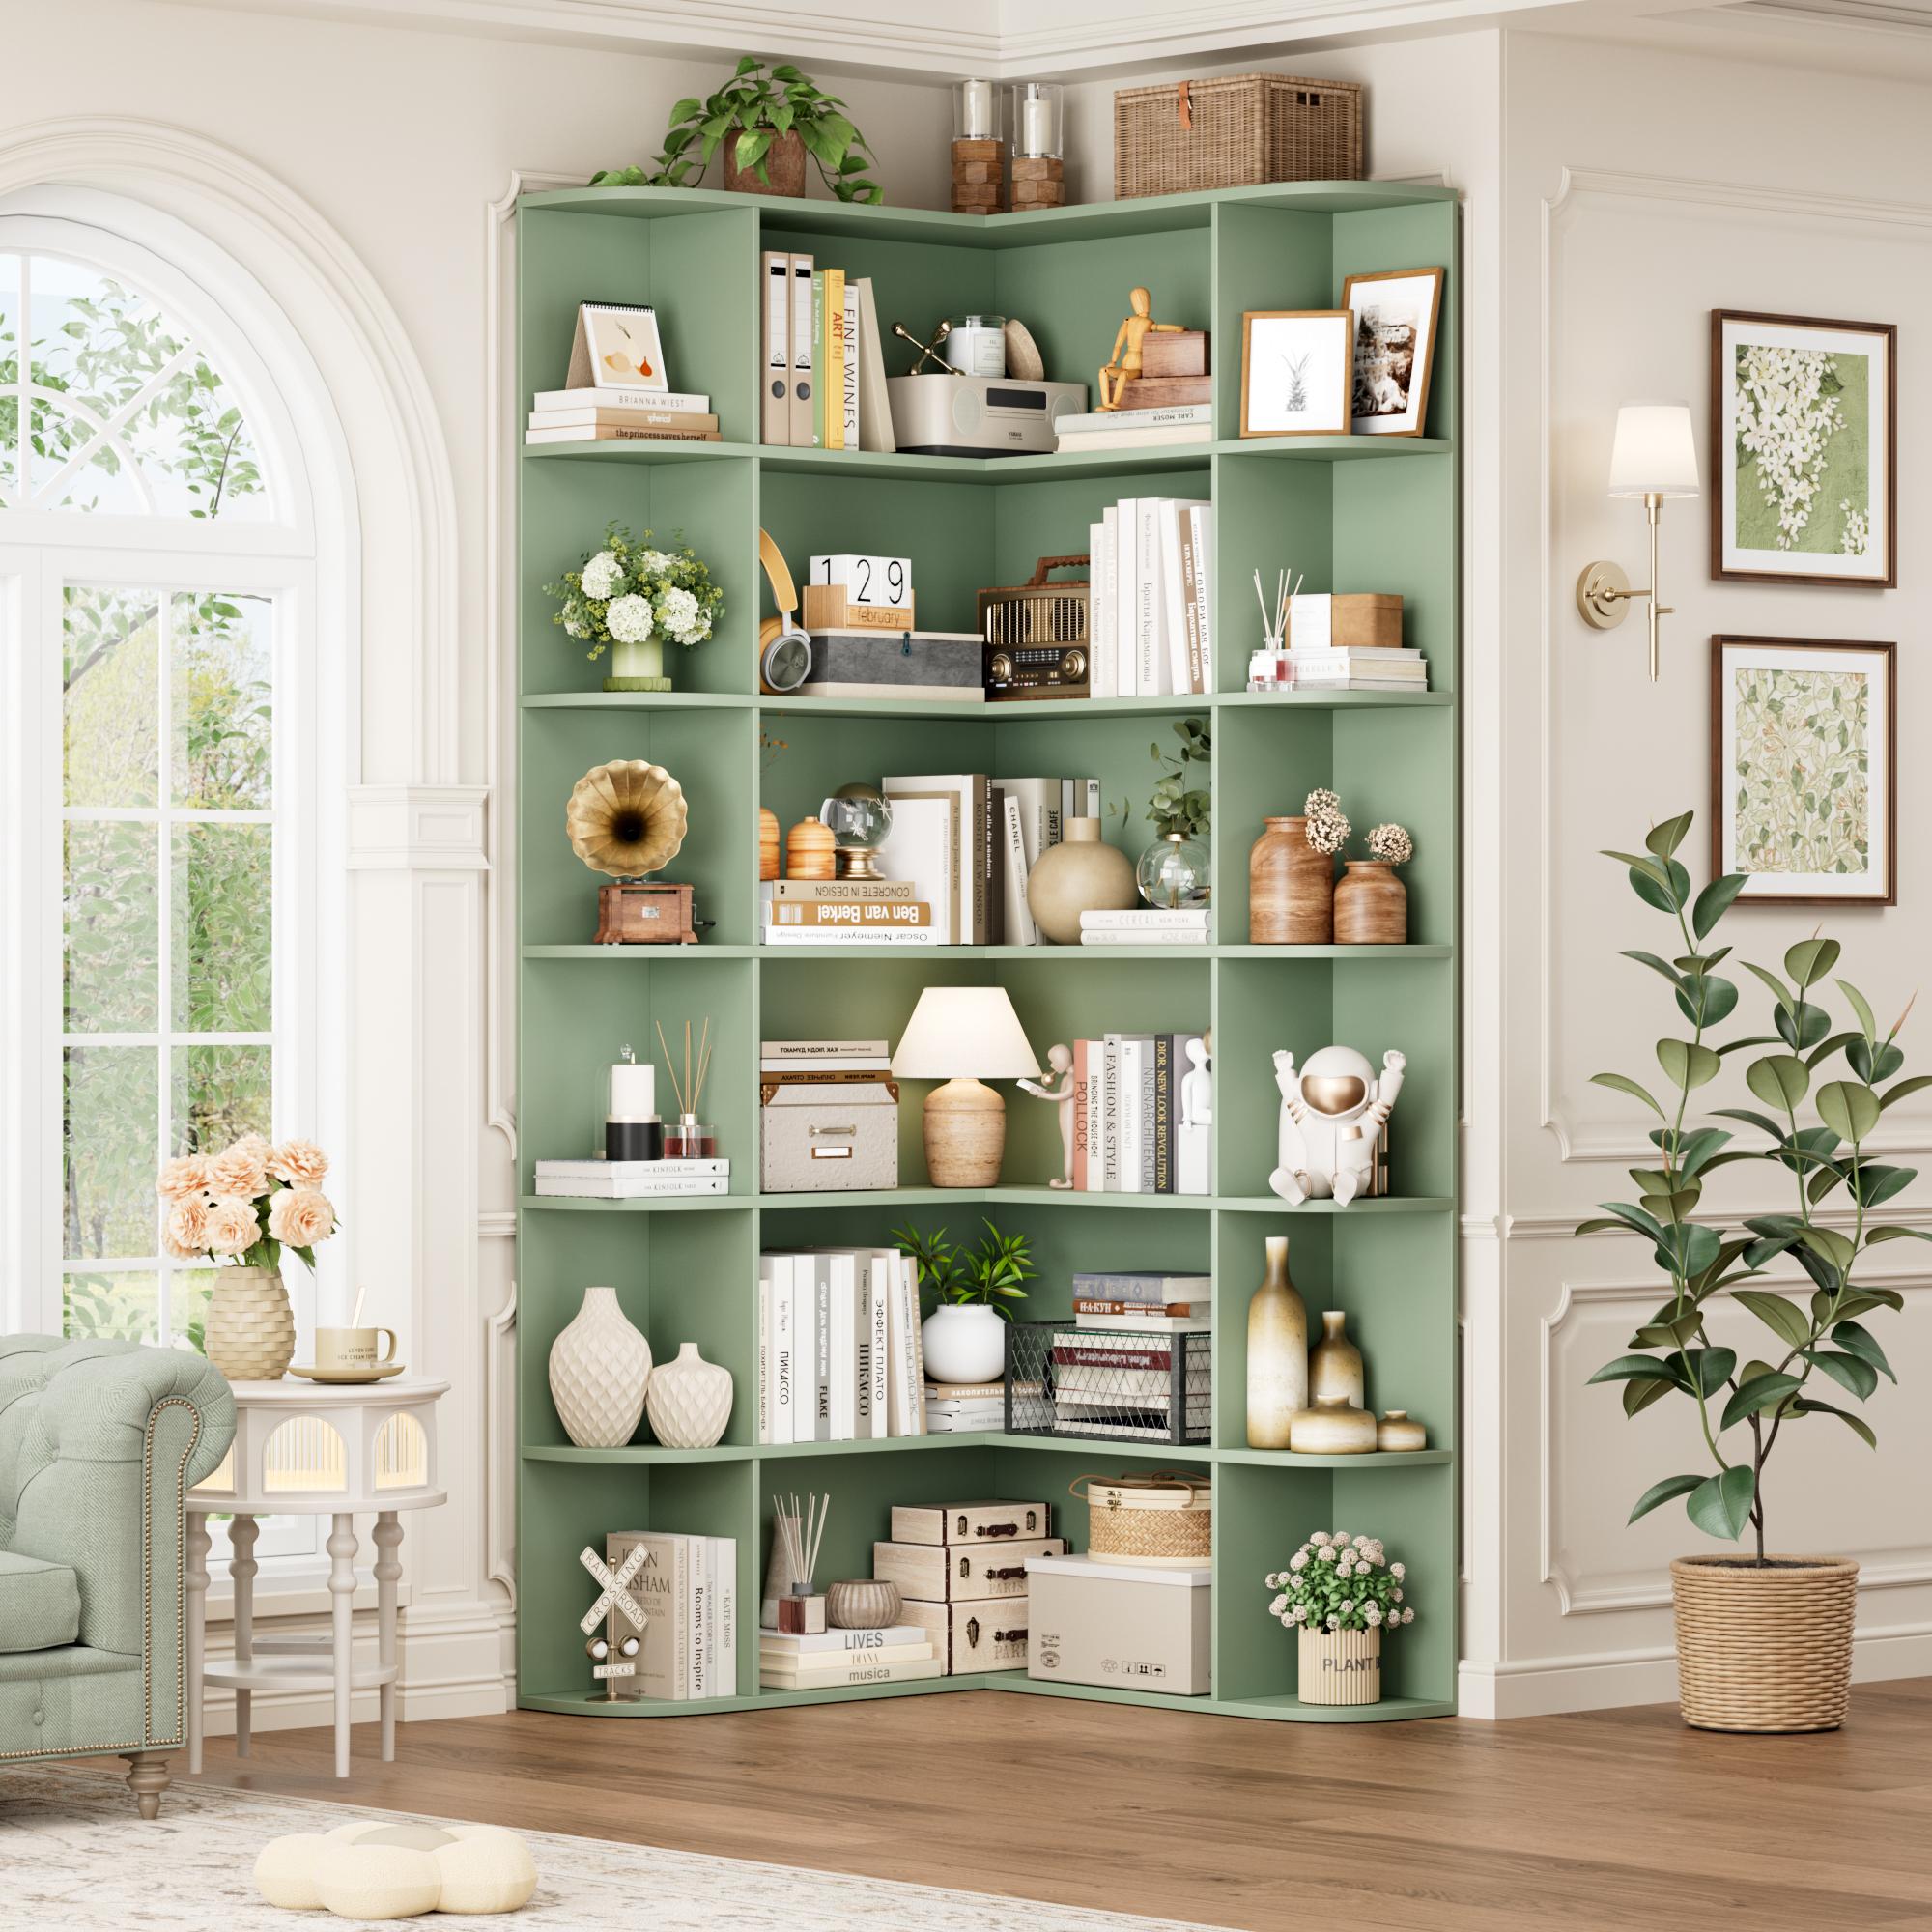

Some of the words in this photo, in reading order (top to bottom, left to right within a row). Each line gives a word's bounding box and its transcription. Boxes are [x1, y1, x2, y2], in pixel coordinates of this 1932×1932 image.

[833, 312, 843, 340] ART
[618, 395, 657, 405] BRIANNA
[661, 399, 685, 408] WIEST
[1140, 582, 1152, 617] Братья
[858, 606, 900, 627] february
[1140, 620, 1152, 682] Карамазовы
[1009, 806, 1021, 853] CHANEL
[816, 886, 849, 897] DESIGN
[851, 886, 860, 896] IN
[863, 886, 910, 897] CONCRETE
[818, 905, 861, 923] Berkel
[865, 905, 889, 919] van
[893, 905, 919, 923] Ben
[840, 932, 893, 941] Niemeyer
[896, 933, 928, 942] Oscar
[1106, 1055, 1117, 1117] FASHION
[1157, 1070, 1167, 1094] NEW
[1076, 1081, 1088, 1151] POLLOCK
[1157, 1095, 1167, 1122] LOOK
[1106, 1122, 1116, 1131] &
[1143, 1064, 1155, 1187] INNENARCHITEKTUR
[1106, 1136, 1116, 1179] STYLE
[1157, 1125, 1167, 1189] REVOLUTION
[780, 1351, 789, 1405] ПИКАССО
[859, 1344, 869, 1417] ПИКАССО
[819, 1385, 828, 1419] FLAKE
[622, 1548, 658, 1568] JN
[585, 1552, 609, 1583] RAIL
[618, 1592, 644, 1625] ROAD
[587, 1553, 642, 1627] CROSSING
[696, 1587, 704, 1629] Rooms
[696, 1633, 702, 1645] to
[845, 1632, 884, 1650] LIVES
[994, 1642, 1028, 1660] PARI
[599, 1666, 633, 1678] TRACKS
[693, 1648, 704, 1690] Inspire
[850, 1667, 891, 1682] musica
